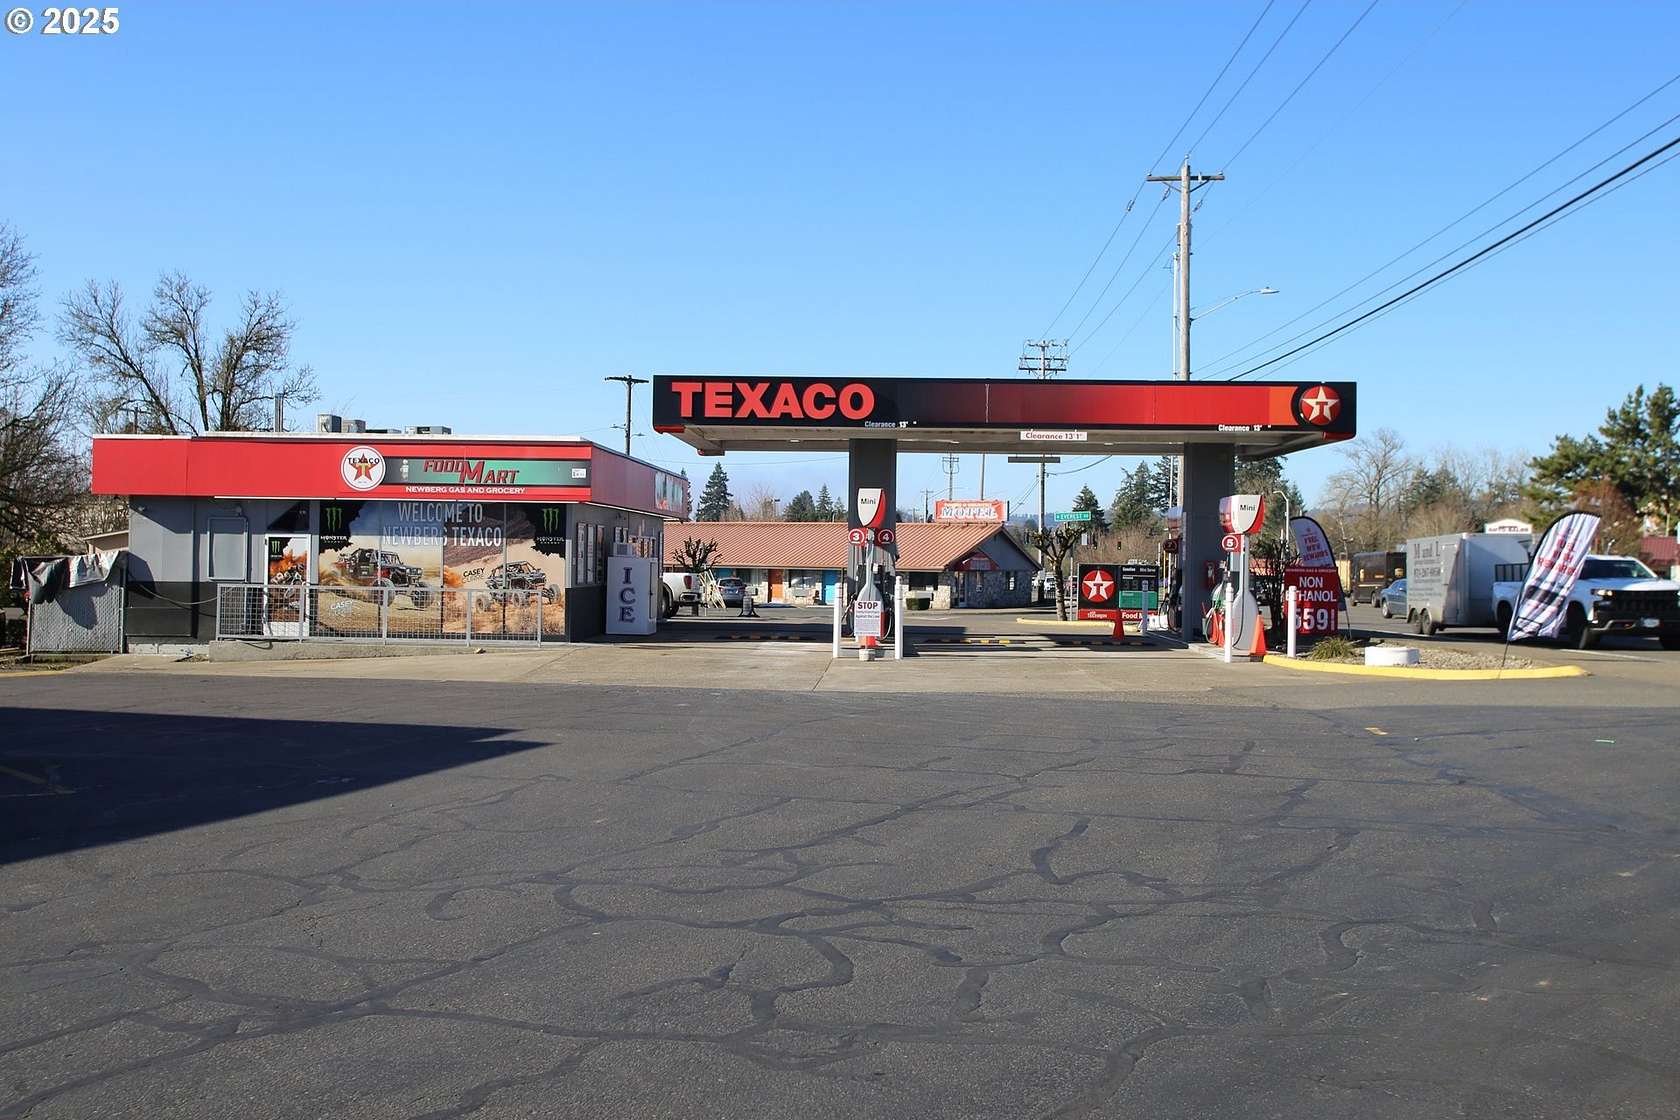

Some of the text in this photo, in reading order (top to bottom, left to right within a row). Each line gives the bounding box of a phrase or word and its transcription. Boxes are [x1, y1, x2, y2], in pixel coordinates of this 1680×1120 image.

[671, 382, 875, 420] TEXACO
[864, 420, 896, 429] Clearance
[1025, 432, 1063, 440] Clearance
[398, 503, 483, 523] WELCOME TO
[941, 506, 998, 519] MOTEL
[452, 526, 501, 547] TEXACO
[852, 532, 860, 541] 3
[882, 533, 890, 541] 4
[1226, 538, 1234, 547] 5
[463, 567, 486, 578] CASEY
[1299, 576, 1324, 588] NON
[618, 567, 636, 623] ICE
[857, 601, 878, 609] STOP
